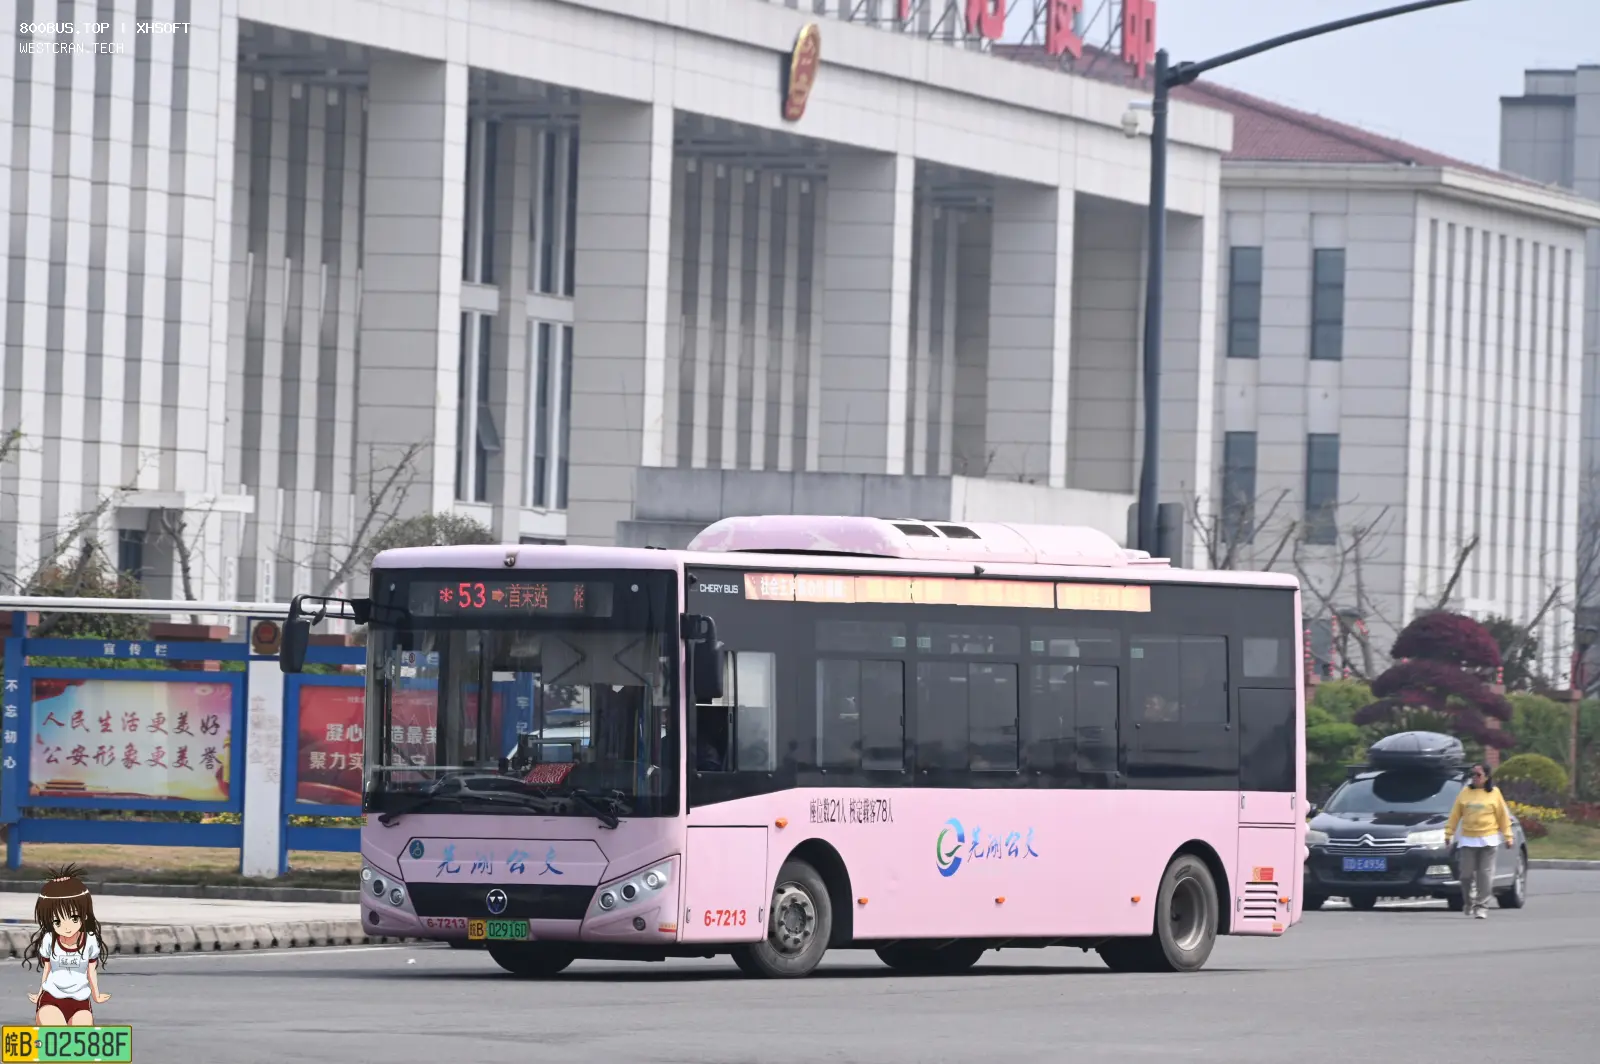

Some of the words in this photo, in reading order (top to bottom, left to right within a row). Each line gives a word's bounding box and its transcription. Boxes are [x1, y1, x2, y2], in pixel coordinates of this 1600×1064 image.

[458, 582, 487, 608] 53
[699, 584, 724, 594] CHERY
[724, 584, 739, 594] BUS
[103, 643, 168, 657] 宣传栏
[4, 679, 18, 770] 不忘初心
[42, 711, 221, 737] 人民生活更美好
[42, 742, 223, 771] 公安形象更美誉
[426, 918, 466, 929] 6-7213
[704, 910, 747, 927] 6-7213
